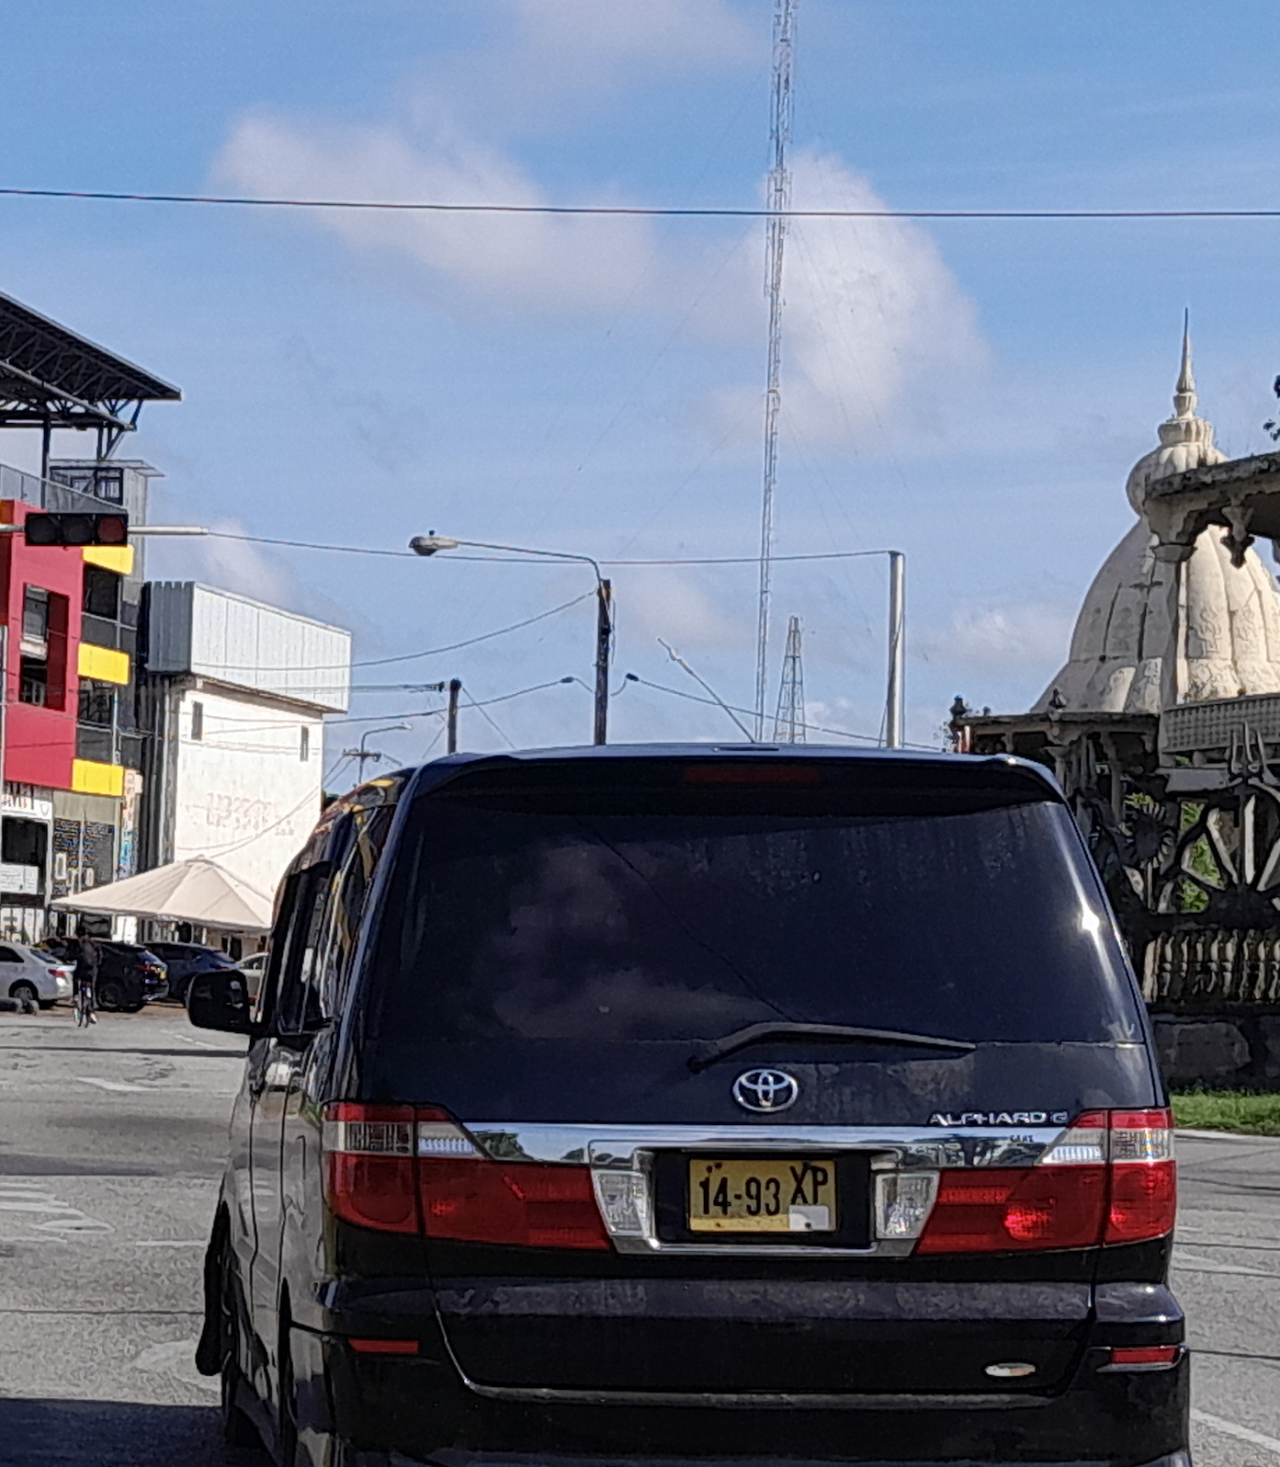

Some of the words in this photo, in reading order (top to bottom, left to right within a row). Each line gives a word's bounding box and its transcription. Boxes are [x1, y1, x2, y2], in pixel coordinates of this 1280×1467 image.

[929, 1111, 1047, 1127] ALPHARD
[699, 1176, 781, 1217] 14-93
[789, 1161, 829, 1205] XP
